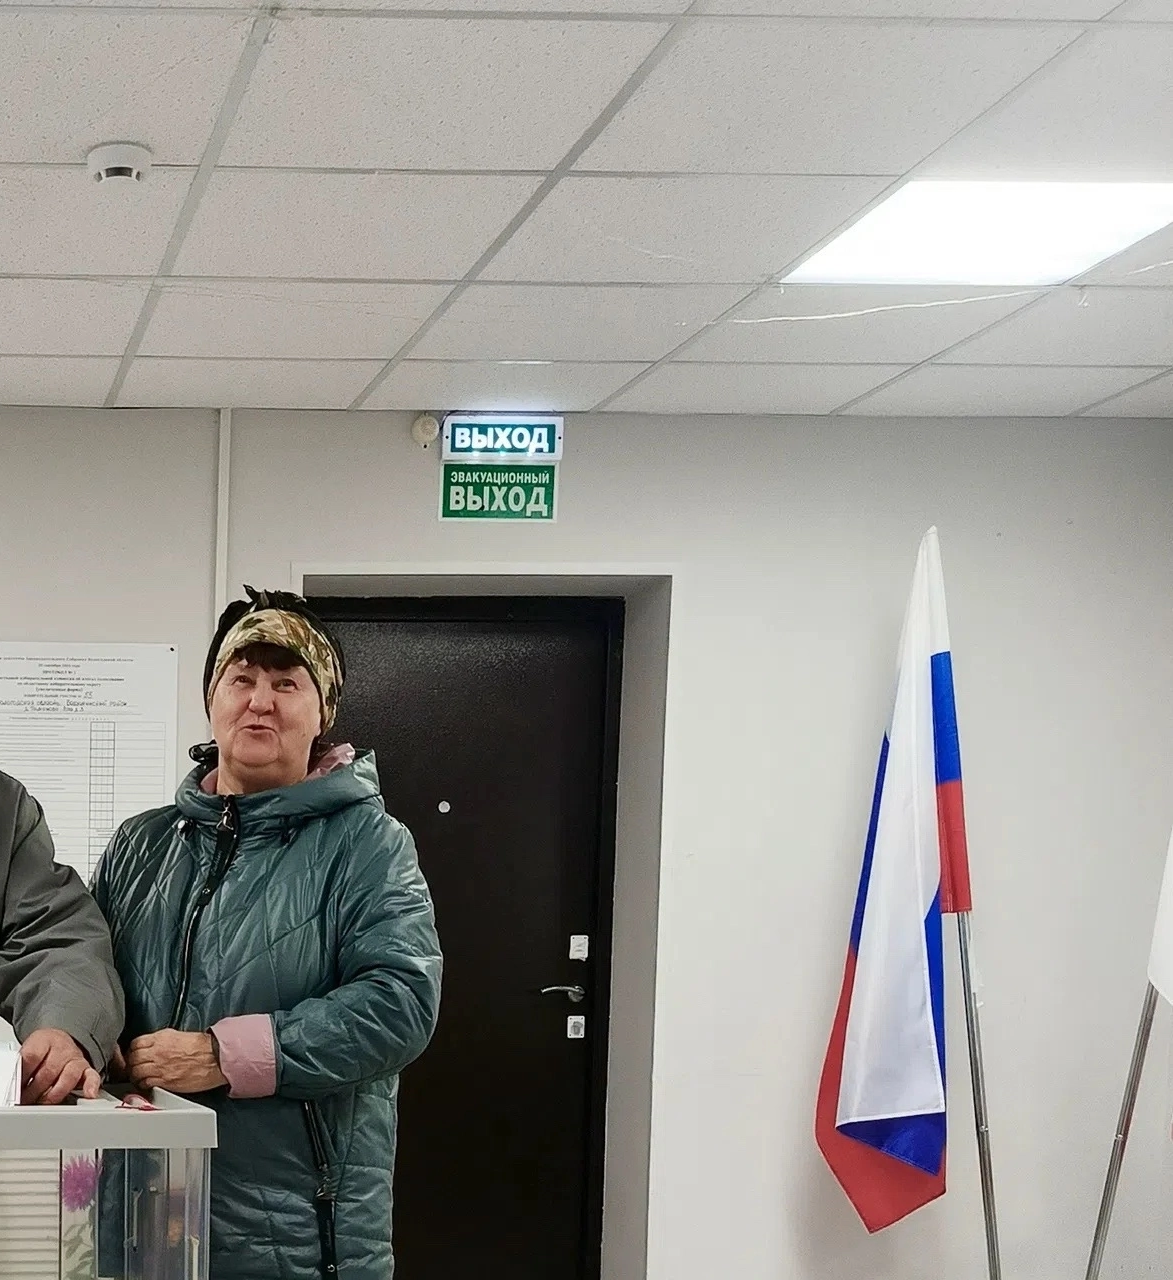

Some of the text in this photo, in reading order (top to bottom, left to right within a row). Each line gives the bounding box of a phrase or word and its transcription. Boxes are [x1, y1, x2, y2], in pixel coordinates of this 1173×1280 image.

[455, 427, 549, 454] ВЫХОД
[451, 471, 549, 485] ЭВАКУАЦИОННЫЙ
[450, 486, 547, 516] ВЫХОД
